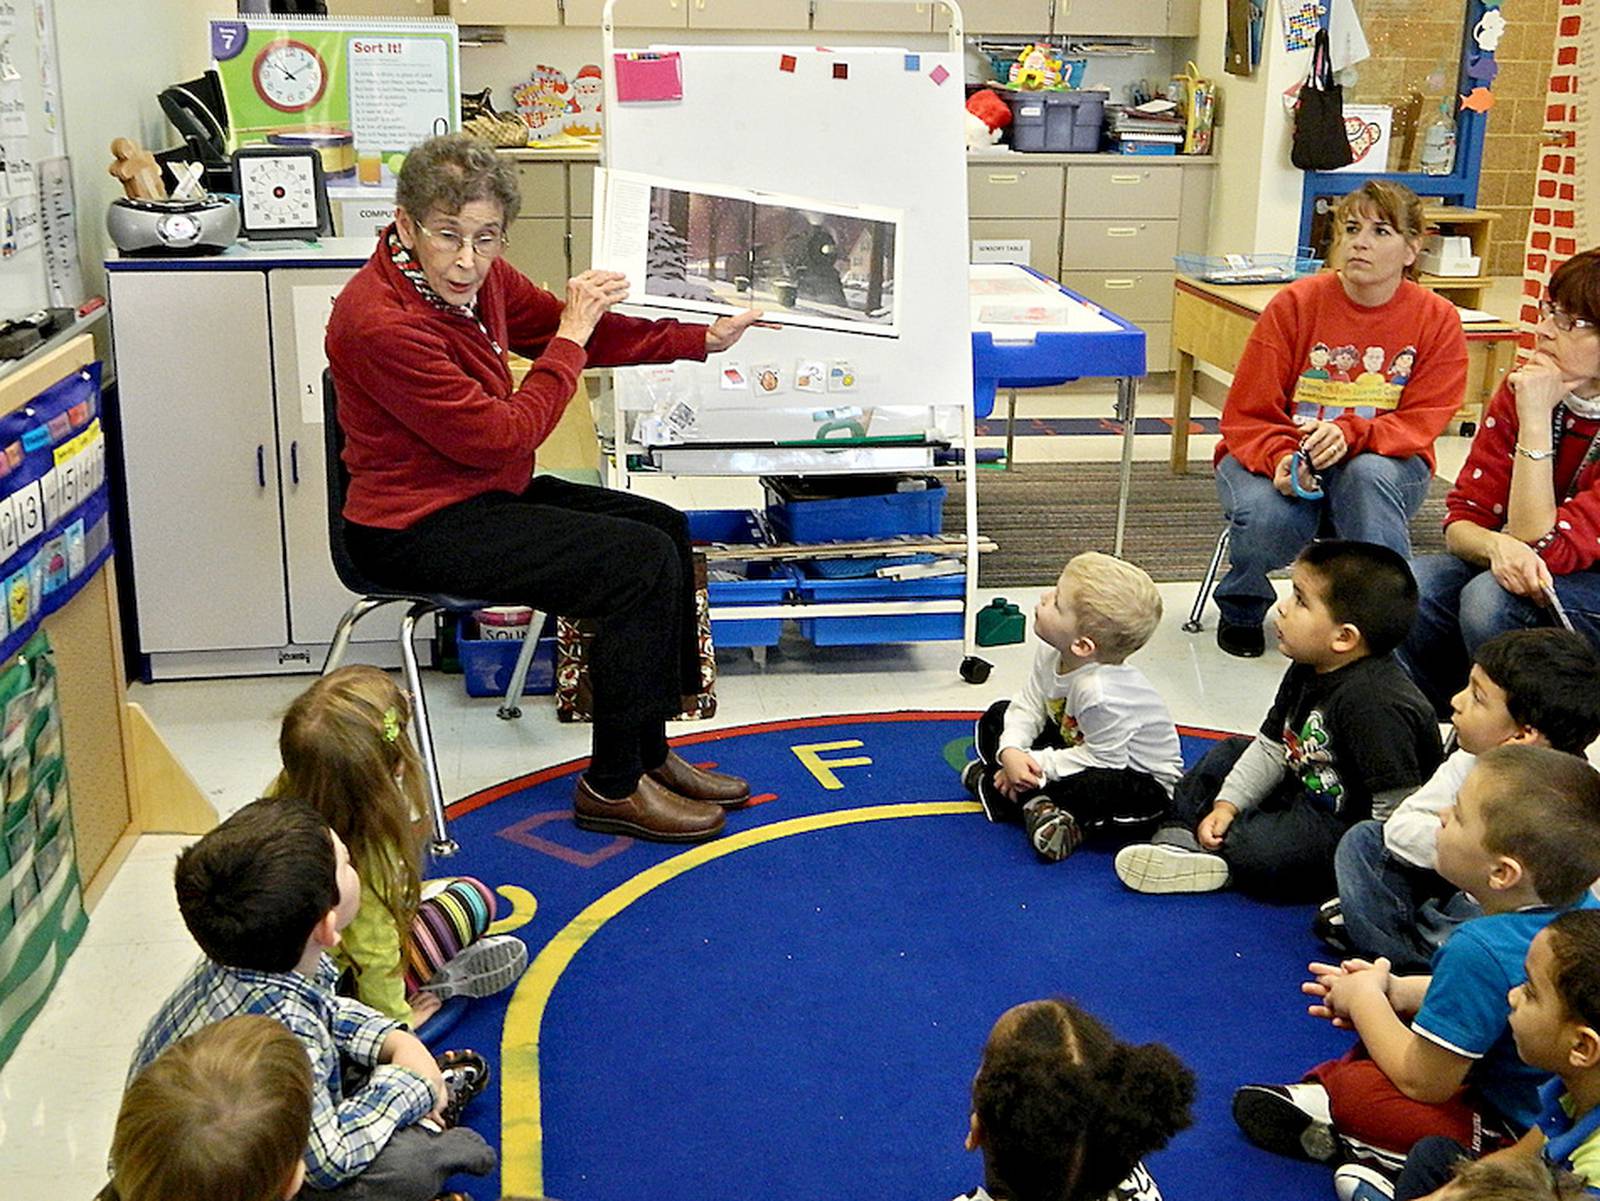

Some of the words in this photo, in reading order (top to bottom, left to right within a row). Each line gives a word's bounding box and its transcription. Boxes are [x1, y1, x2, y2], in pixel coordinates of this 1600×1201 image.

[221, 34, 234, 50] 7
[353, 42, 384, 53] Sort
[387, 43, 402, 54] It!
[19, 496, 38, 534] 13
